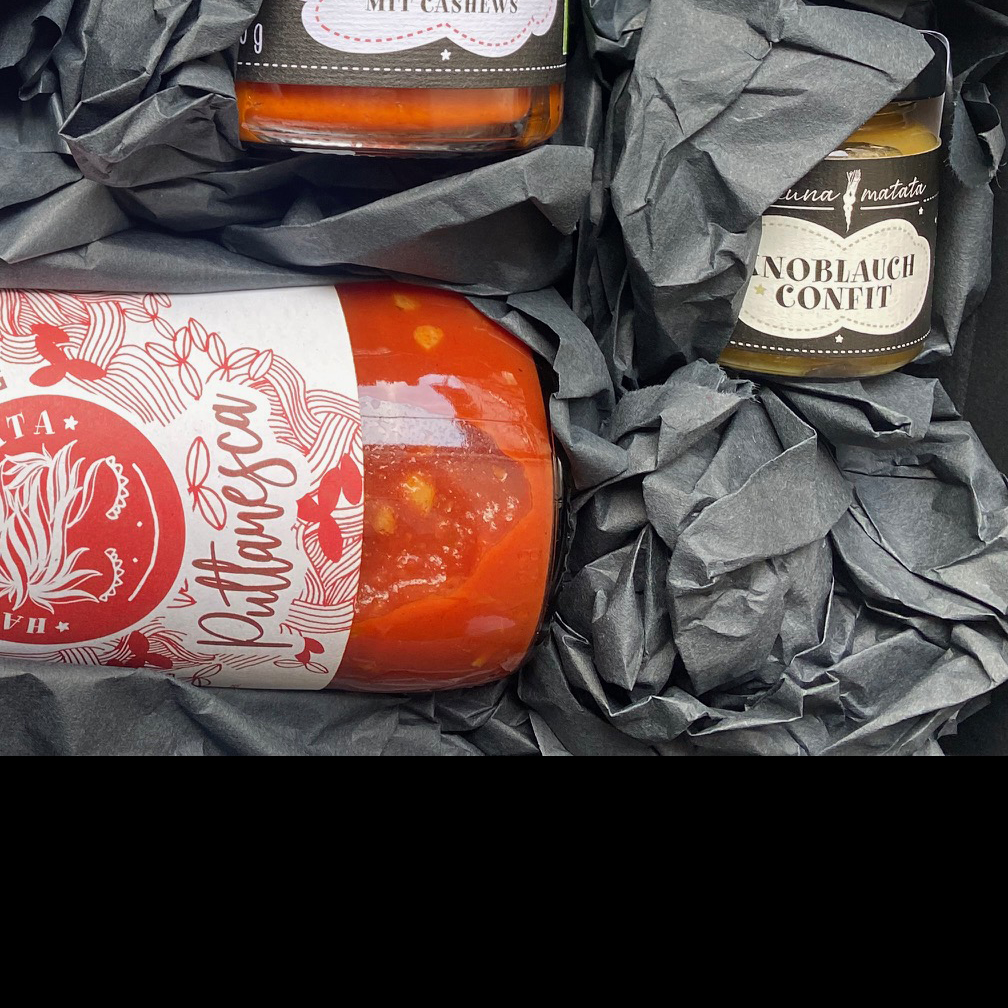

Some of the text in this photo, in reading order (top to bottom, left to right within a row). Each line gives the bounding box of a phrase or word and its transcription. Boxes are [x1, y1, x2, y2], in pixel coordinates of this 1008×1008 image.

[778, 176, 927, 203] una matata
[775, 283, 893, 311] CONFIT
